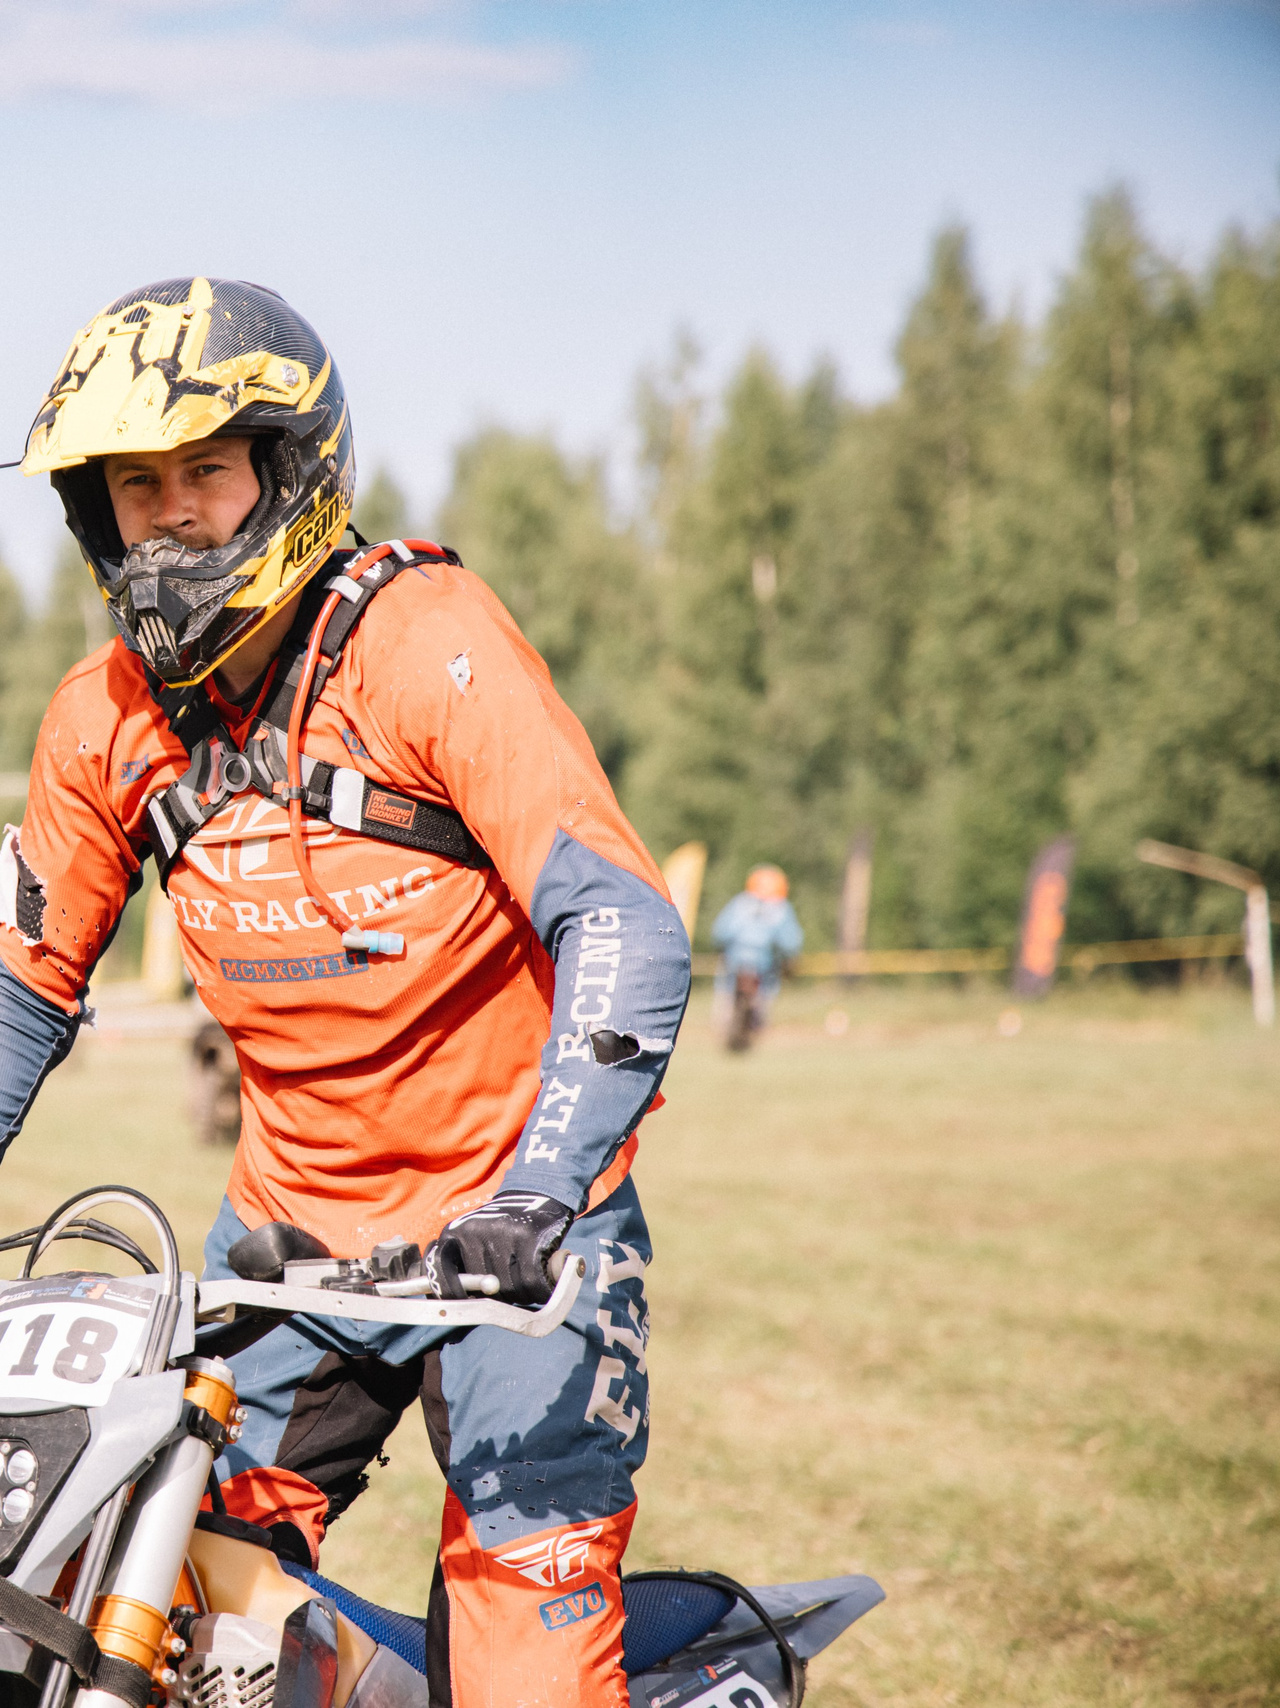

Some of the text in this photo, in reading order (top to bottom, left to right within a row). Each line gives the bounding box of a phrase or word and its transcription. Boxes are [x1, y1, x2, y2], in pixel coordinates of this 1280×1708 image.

[371, 801, 412, 817] DANCING
[373, 794, 388, 804] NO
[369, 808, 409, 823] MONKEY
[229, 866, 436, 933] RACING
[222, 952, 364, 980] MCMXCVIII
[525, 907, 622, 1165] FLY RCING
[544, 1587, 603, 1629] EVO
